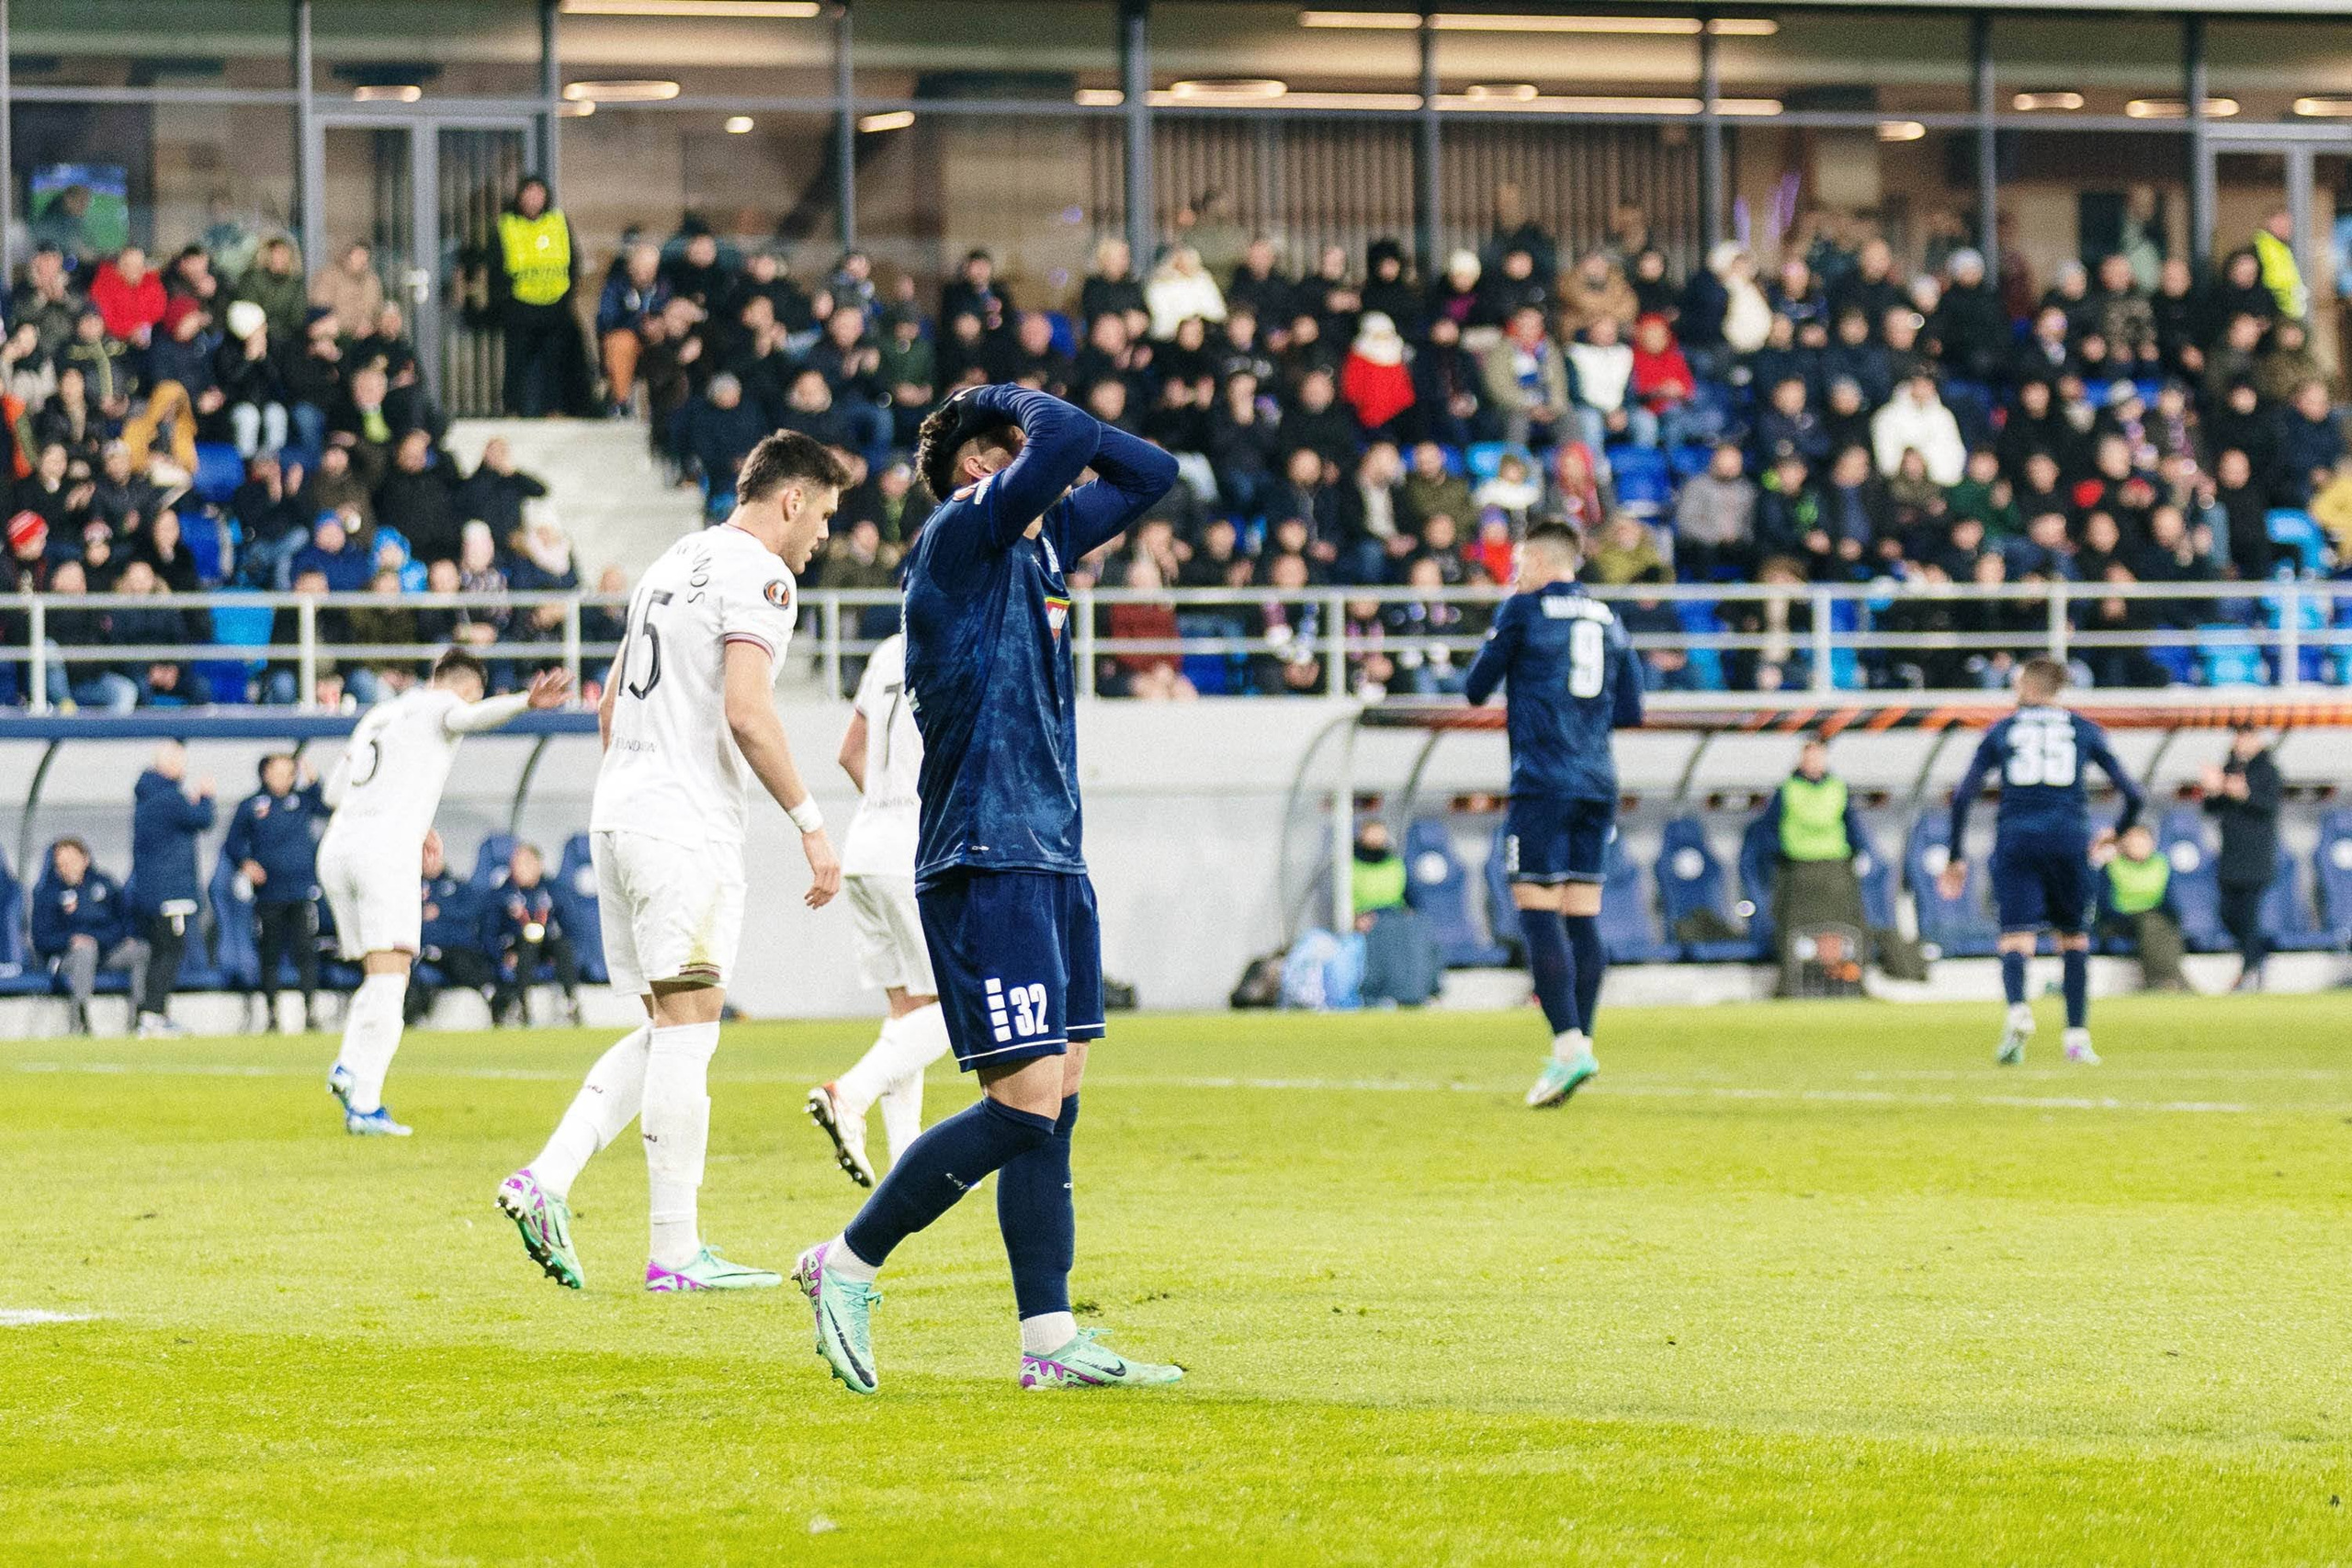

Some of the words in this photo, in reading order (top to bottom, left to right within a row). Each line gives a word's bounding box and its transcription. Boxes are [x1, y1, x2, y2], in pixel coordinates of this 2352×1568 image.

[1568, 619, 1604, 698] 9
[884, 682, 902, 772] 7
[2006, 721, 2077, 786] 35
[1009, 983, 1049, 1036] 32
